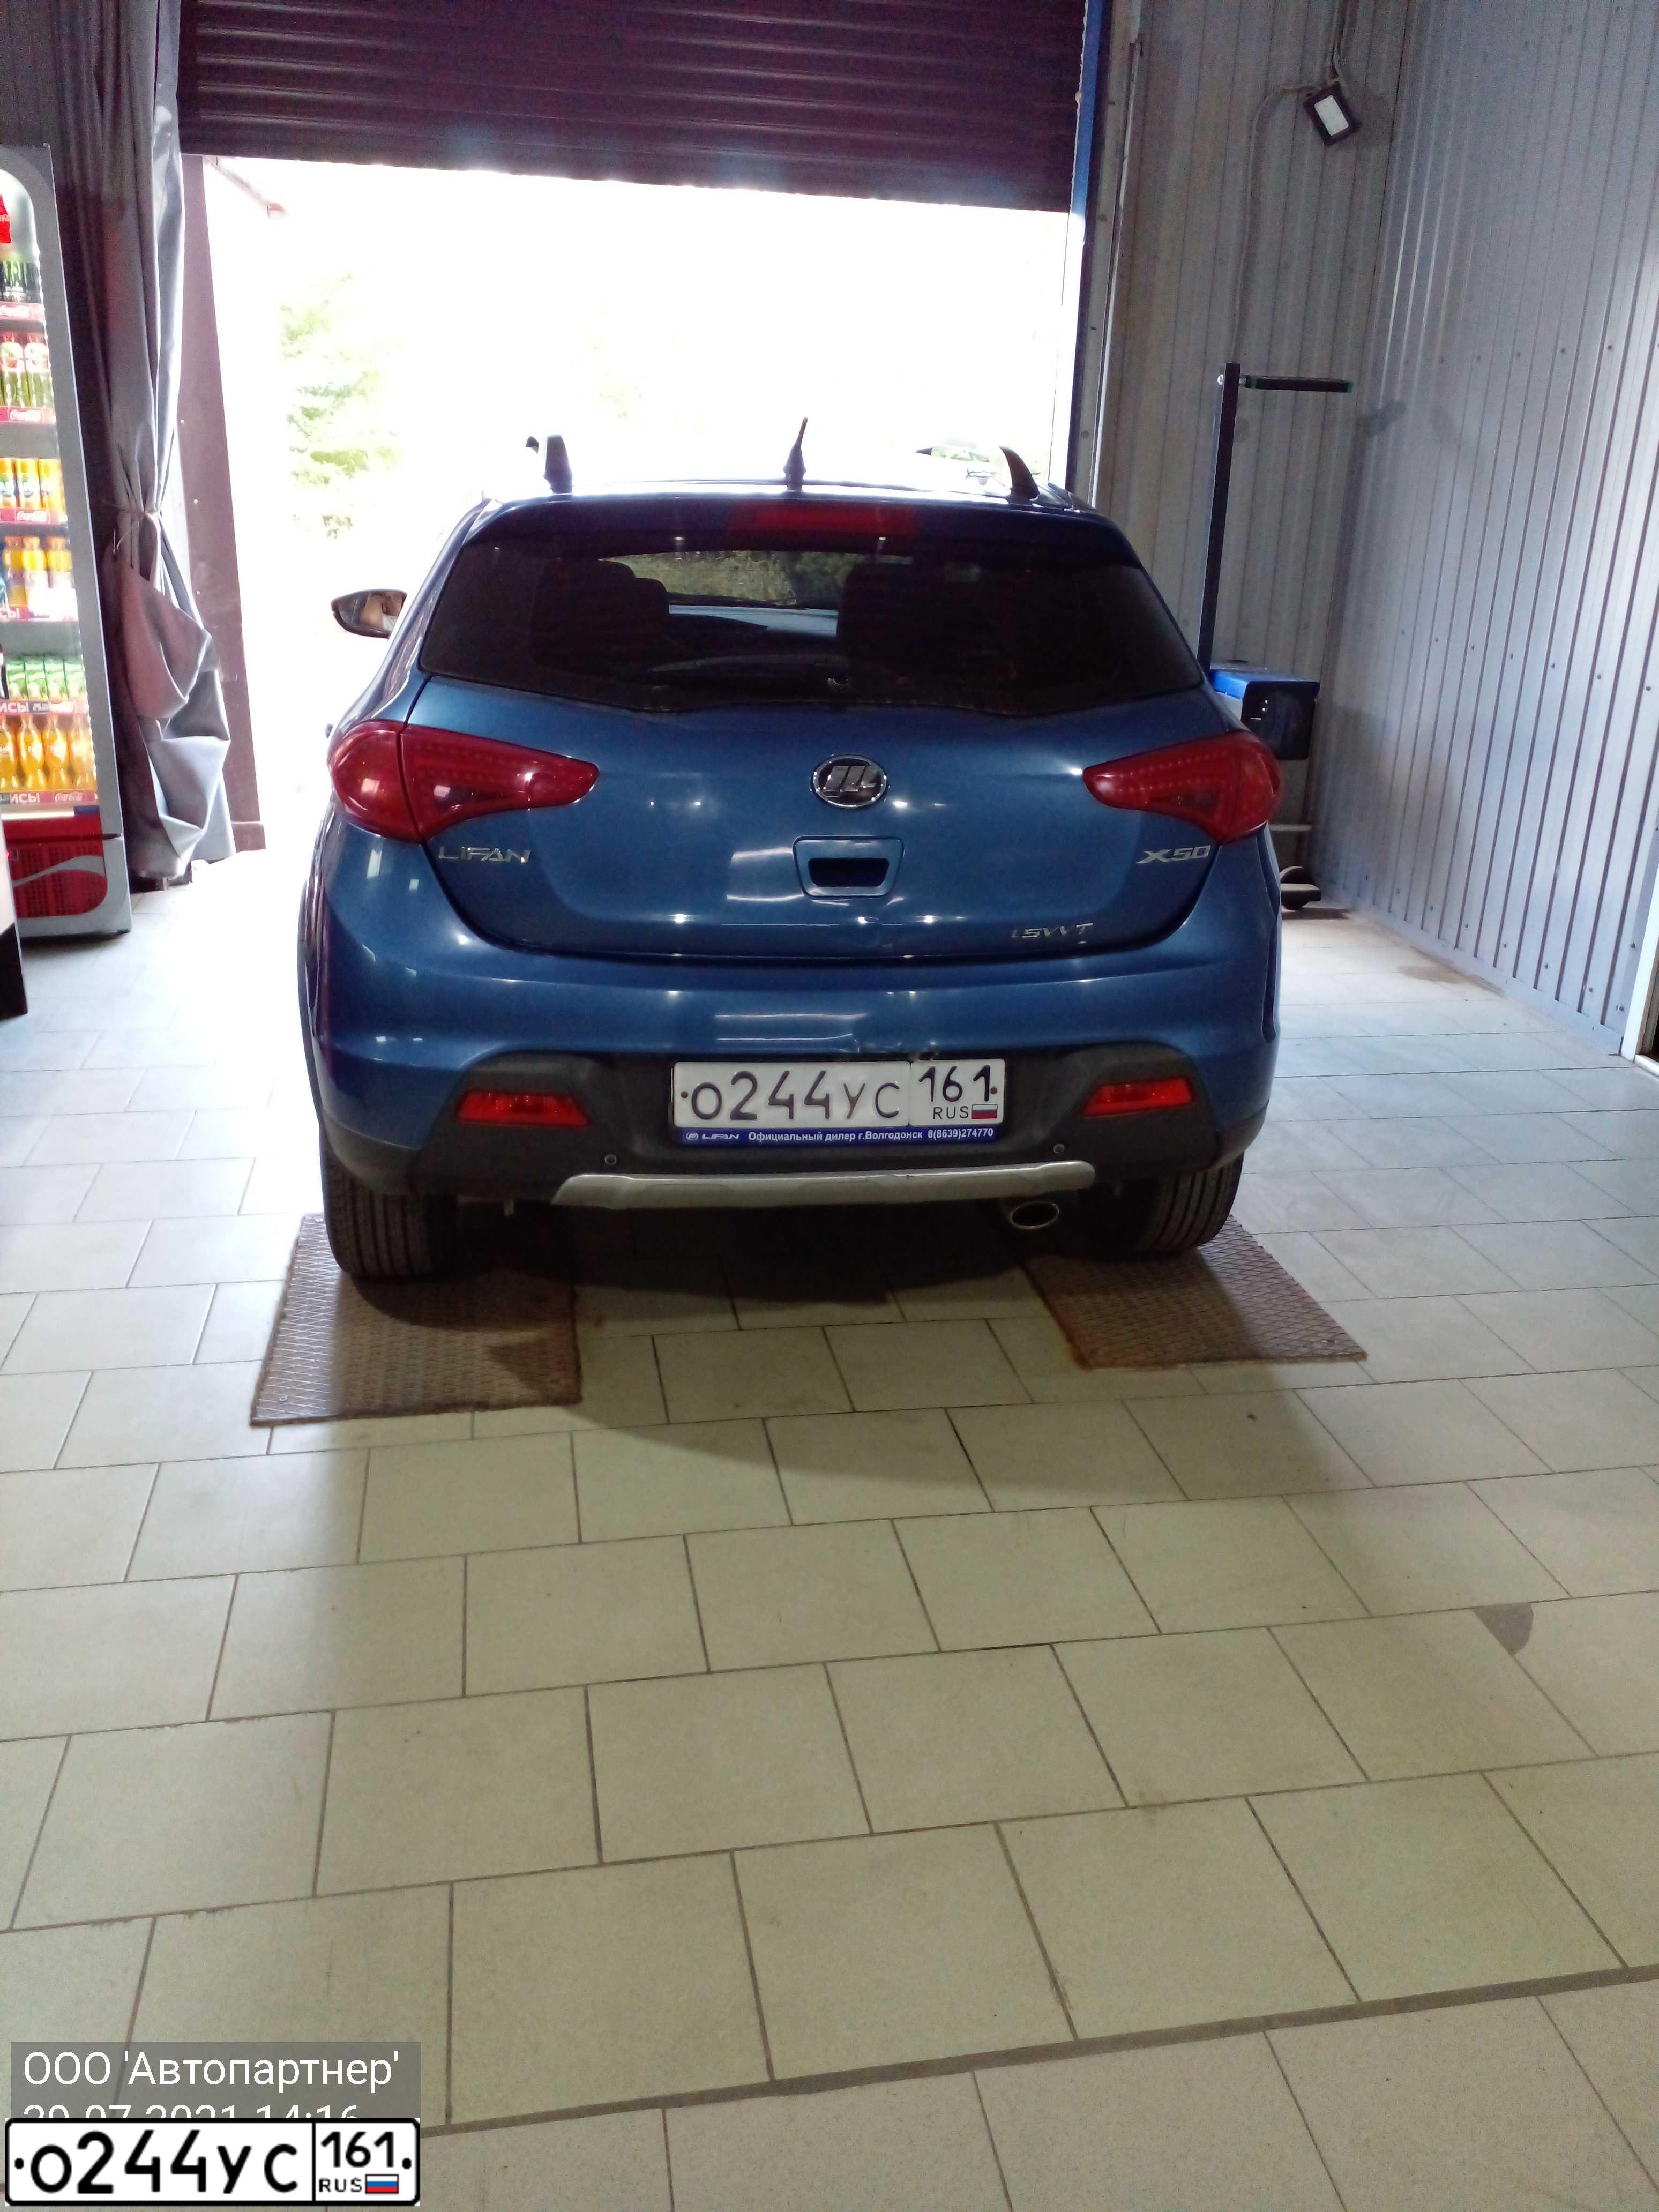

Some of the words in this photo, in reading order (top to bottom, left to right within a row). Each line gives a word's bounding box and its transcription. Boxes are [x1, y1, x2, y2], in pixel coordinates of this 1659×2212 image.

[438, 846, 532, 863] LIFAN
[1136, 845, 1211, 864] X50
[918, 1065, 990, 1102] 161
[933, 1105, 969, 1120] RUS
[748, 1131, 822, 1142] Официальный
[825, 1131, 856, 1142] дилер
[858, 1129, 923, 1141] г.Волгодонск
[928, 1127, 993, 1139] 8(8639)274770
